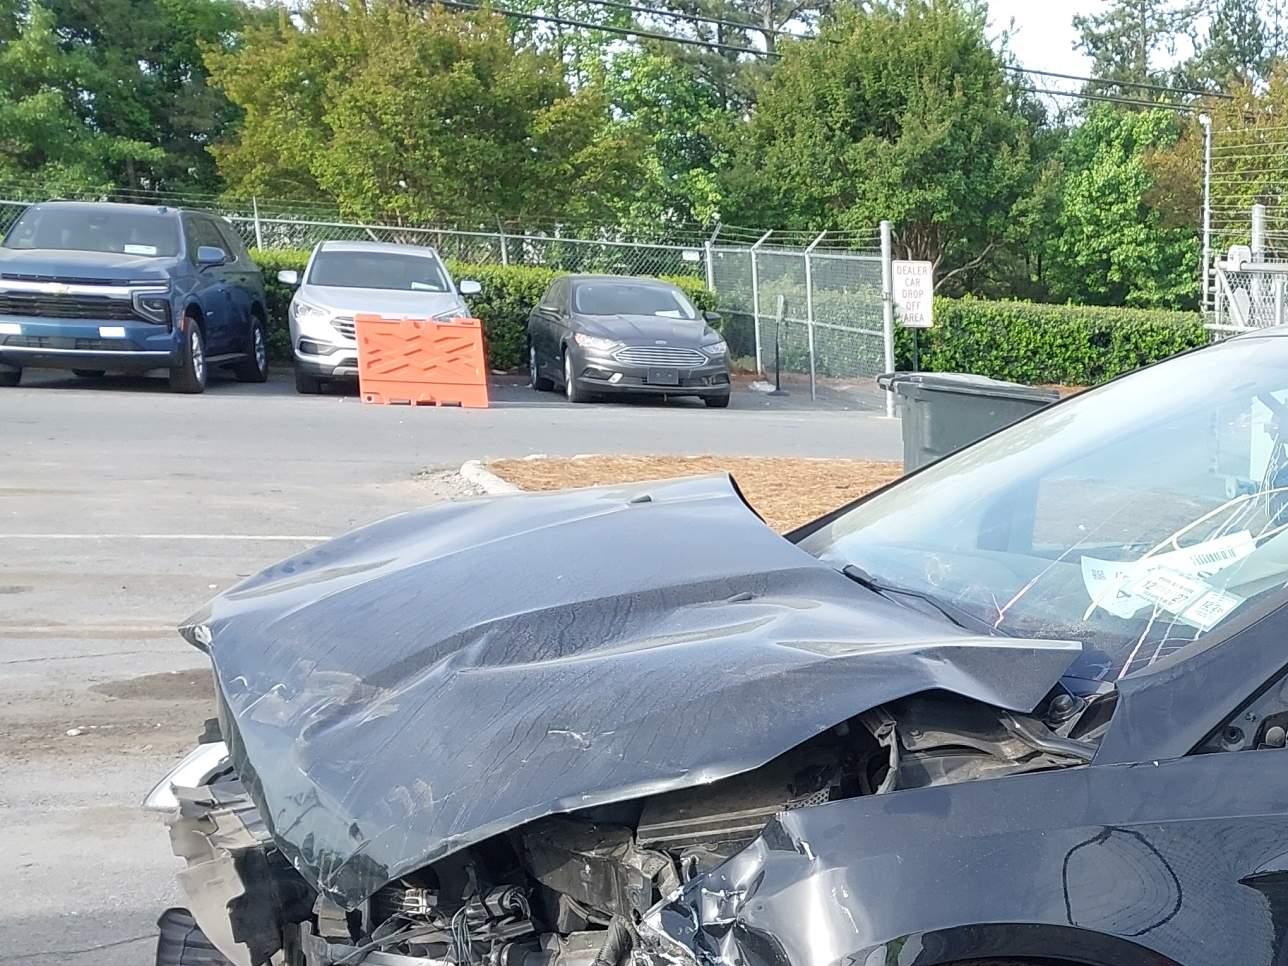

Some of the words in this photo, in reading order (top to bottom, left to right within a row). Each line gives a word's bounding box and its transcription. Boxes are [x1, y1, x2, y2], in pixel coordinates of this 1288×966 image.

[897, 265, 927, 275] DEALER
[904, 277, 921, 287] CAR
[903, 290, 924, 299] DROP
[906, 301, 920, 311] OFF
[904, 313, 925, 322] AREA
